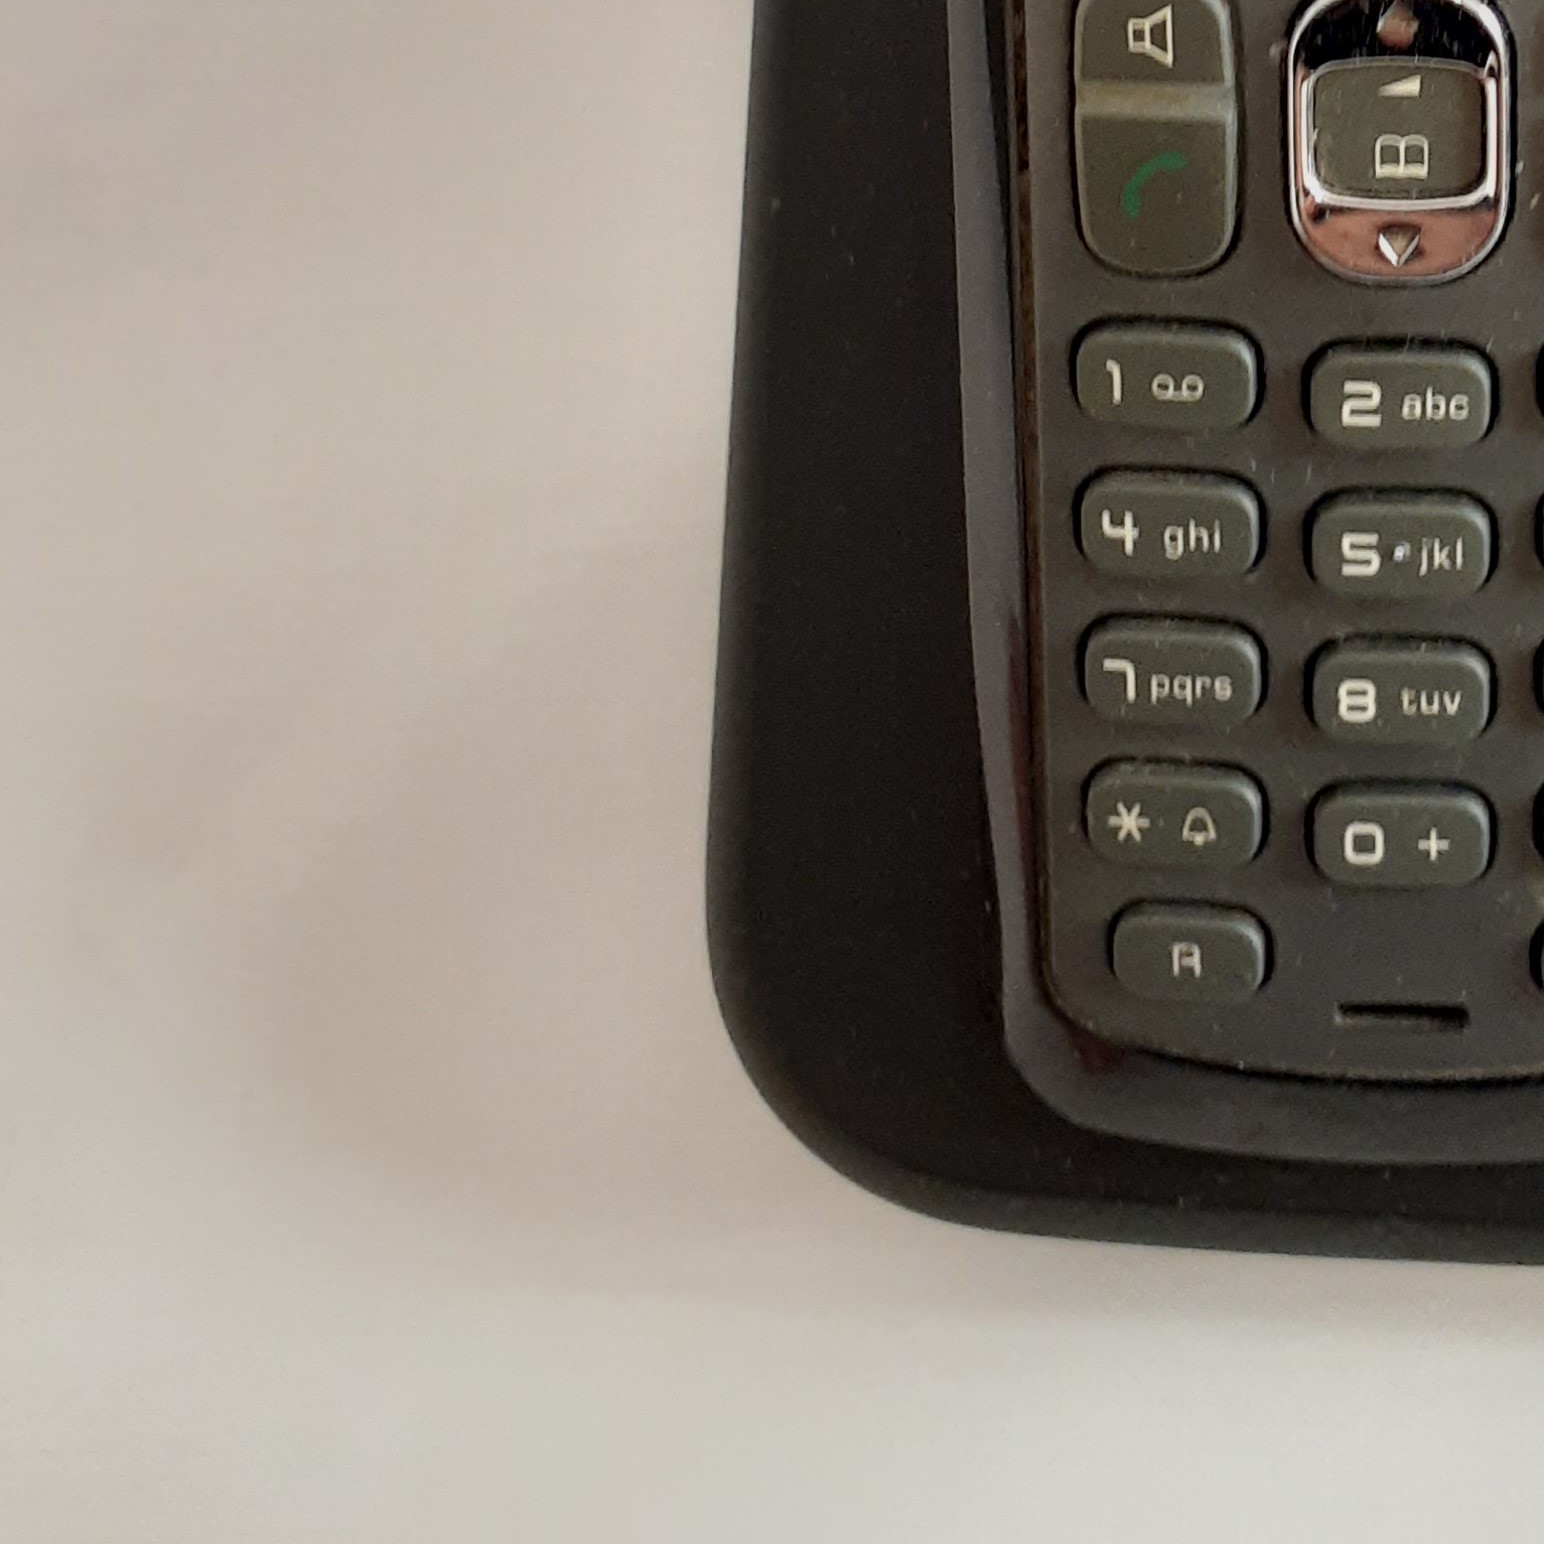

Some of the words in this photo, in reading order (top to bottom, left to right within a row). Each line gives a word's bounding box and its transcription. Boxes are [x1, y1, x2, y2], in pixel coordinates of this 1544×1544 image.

[1105, 358, 1122, 406] 1
[1341, 379, 1382, 428] 2
[1401, 386, 1470, 422] abc
[1101, 508, 1138, 555] 4
[1163, 518, 1222, 561] ghi
[1341, 531, 1381, 578] 5
[1417, 535, 1464, 577] jkl
[1102, 657, 1137, 704] 7
[1150, 670, 1233, 706] pqrs
[1337, 677, 1377, 723] 8
[1401, 685, 1463, 717] tuv
[1344, 821, 1384, 867] 0
